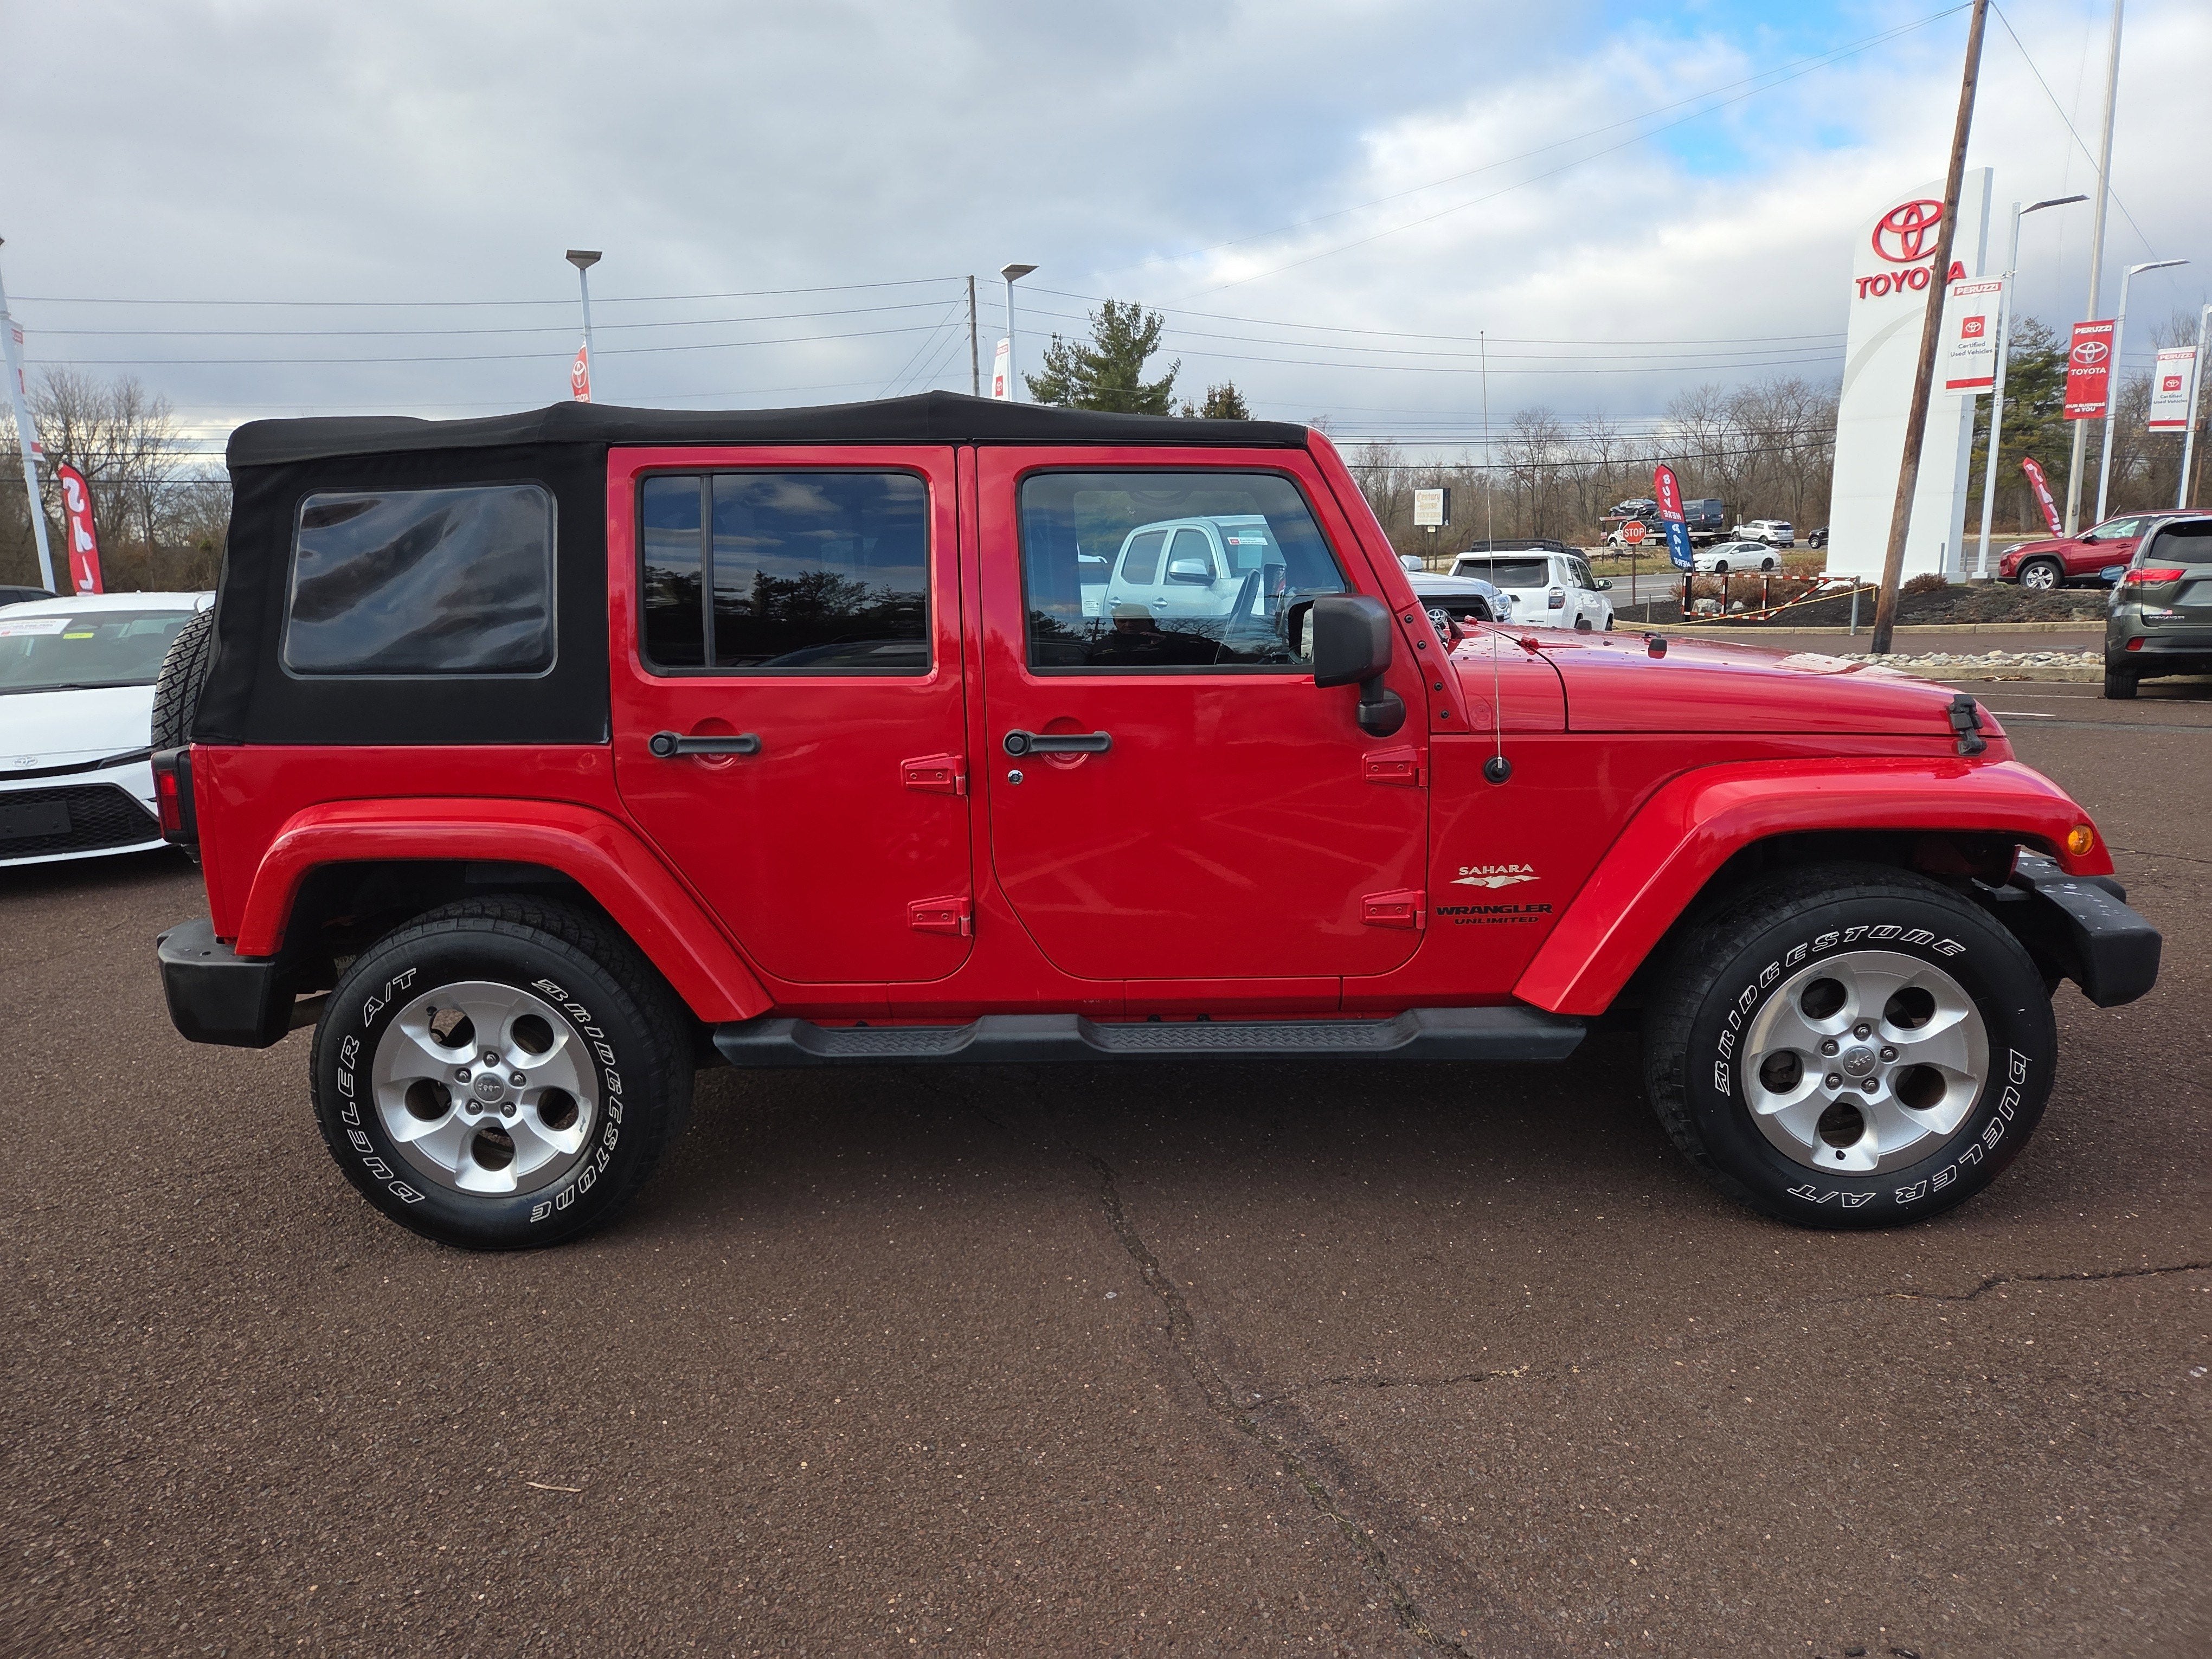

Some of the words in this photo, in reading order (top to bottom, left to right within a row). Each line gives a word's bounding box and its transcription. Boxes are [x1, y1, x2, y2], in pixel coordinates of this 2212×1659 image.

[1856, 261, 1967, 299] TOYOA
[1956, 283, 1999, 295] PERUZZI
[2075, 325, 2112, 335] PERUZZI
[1958, 341, 1985, 349] Certified
[2070, 367, 2106, 376] TOYOTA
[1416, 492, 1441, 503] Century
[1624, 528, 1645, 537] STOP
[1459, 864, 1534, 875] SAHARA
[1436, 903, 1553, 915] WRANGLER
[1455, 916, 1539, 925] UNLIMITED
[364, 968, 416, 1027] A/T
[1714, 924, 1966, 1096] BRIDGESTONE
[531, 979, 623, 1223] BRIDGESTONE
[338, 1036, 426, 1204] DUELER
[1895, 1048, 2033, 1205] DUELER
[1787, 1184, 1876, 1208] A/T
